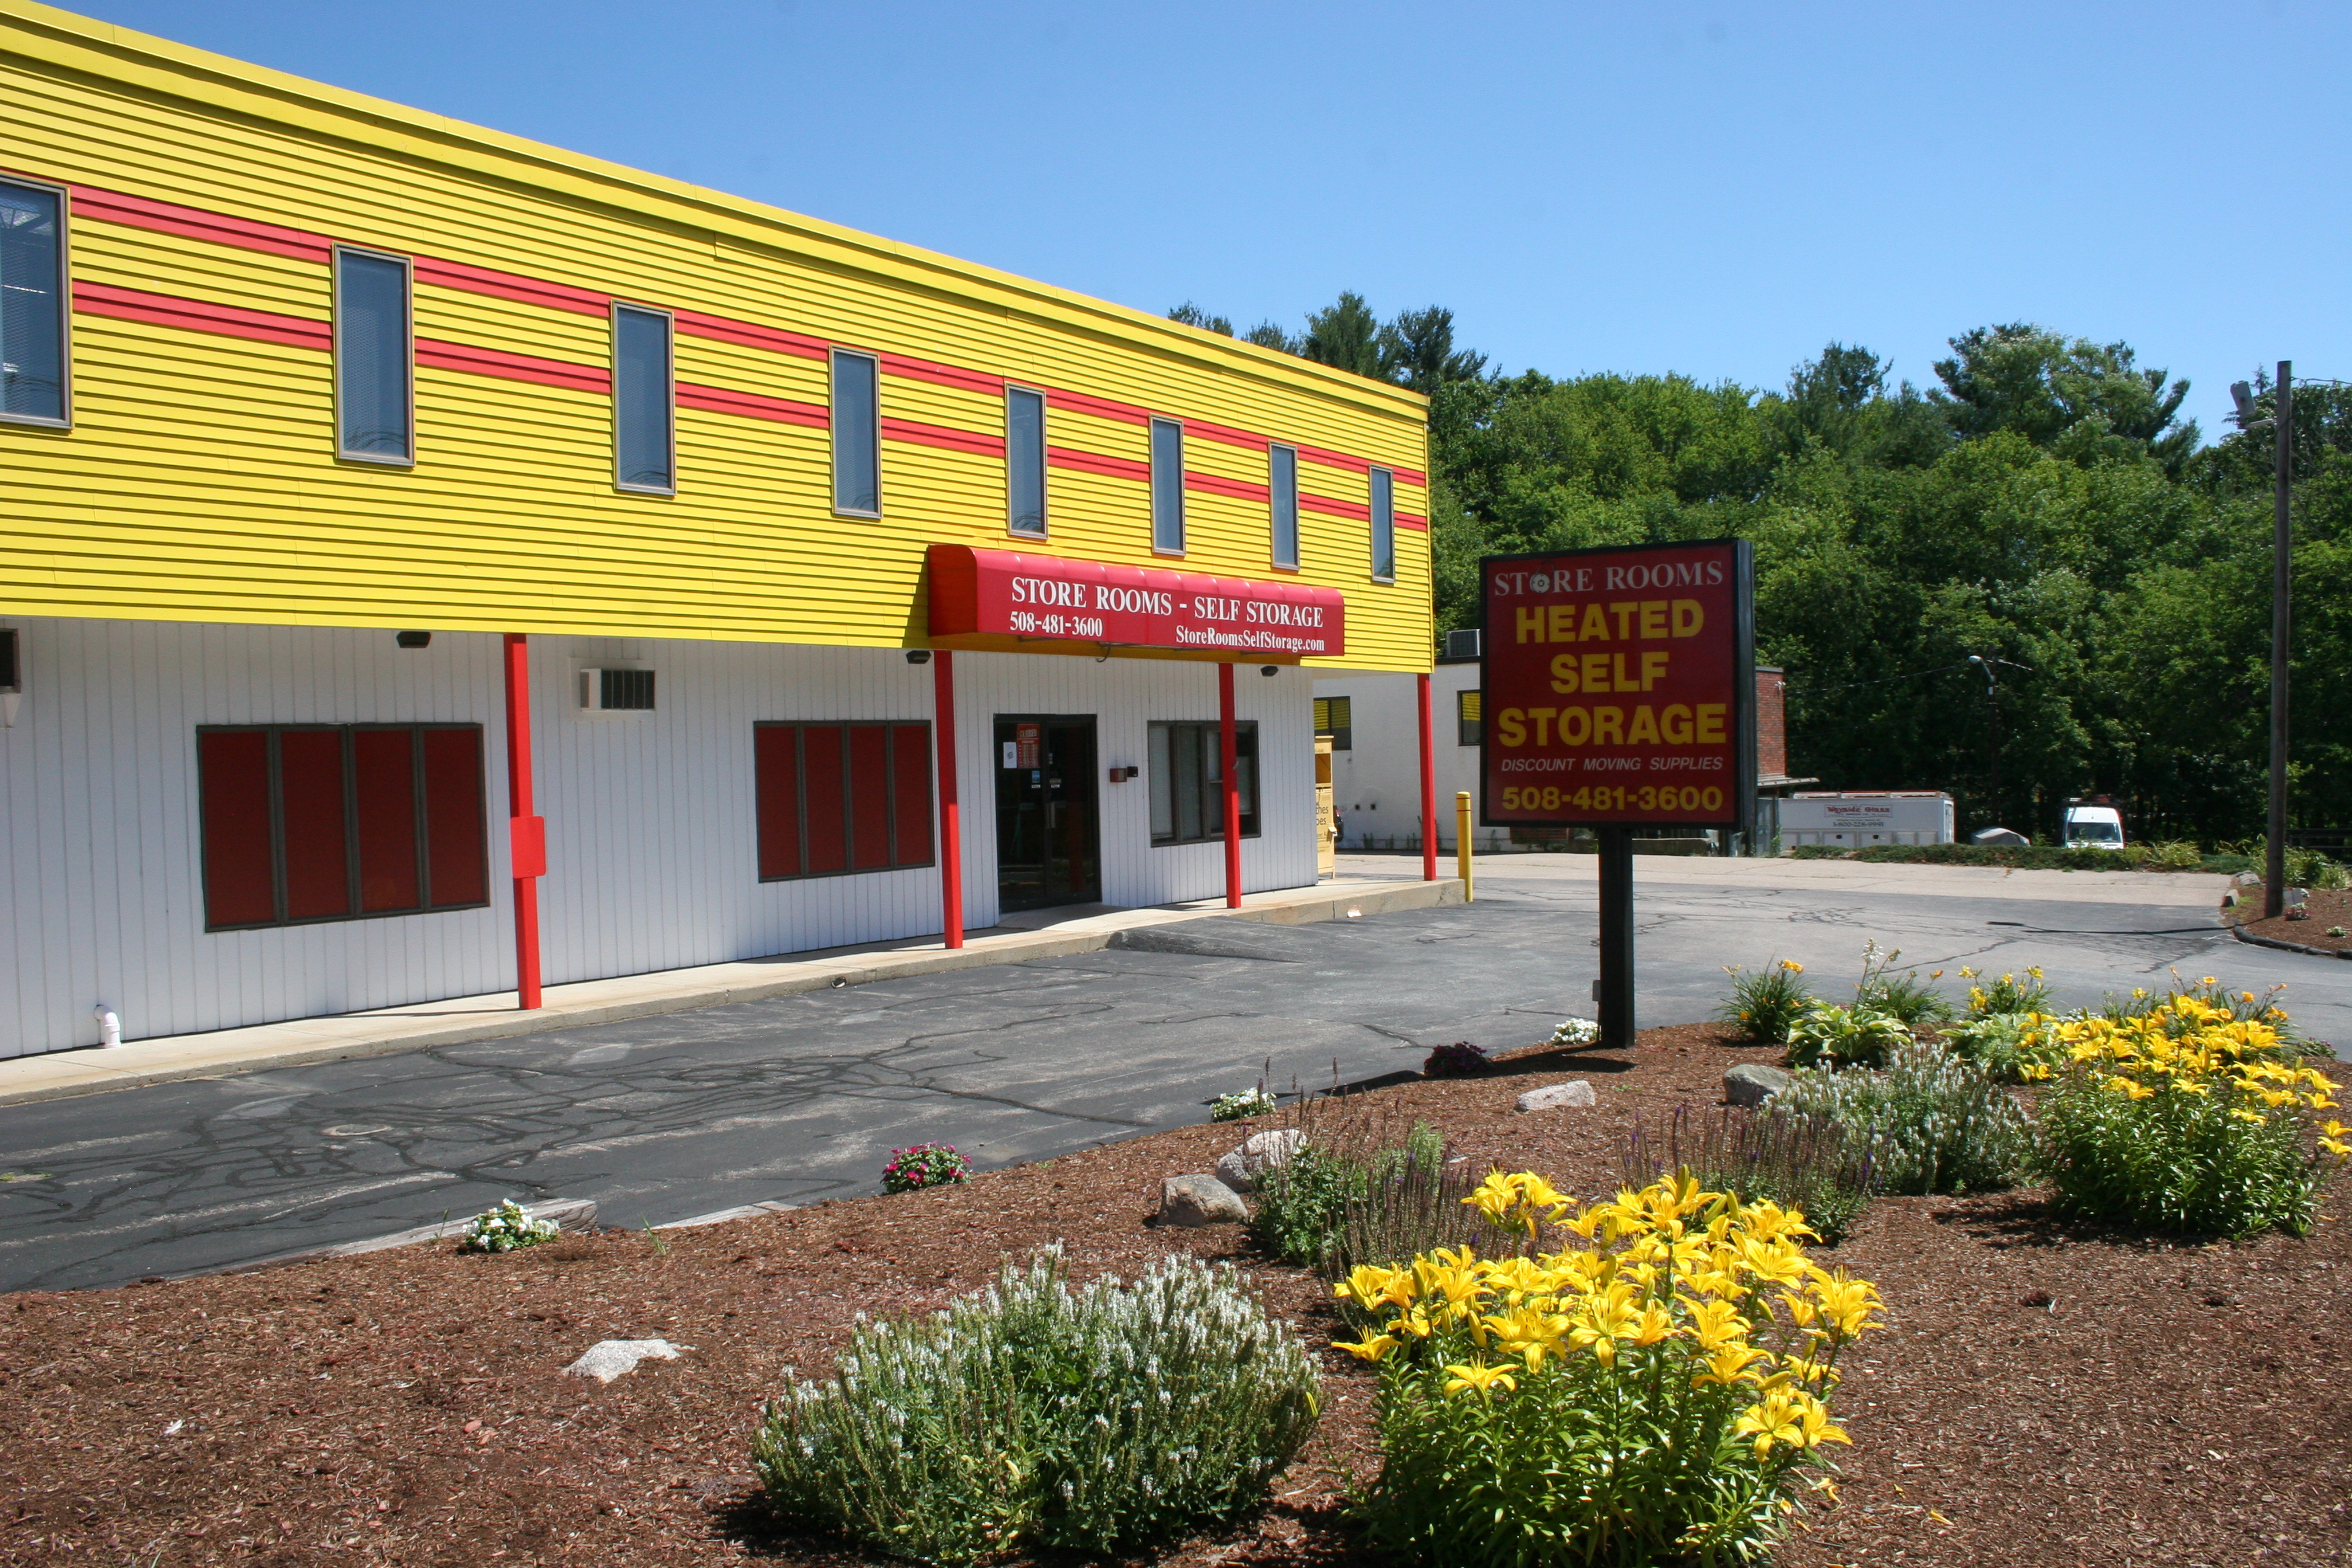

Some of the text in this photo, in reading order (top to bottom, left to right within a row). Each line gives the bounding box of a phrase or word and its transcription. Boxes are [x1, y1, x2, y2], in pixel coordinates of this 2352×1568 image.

[1495, 560, 1723, 597] STORE ROOMS
[1012, 577, 1087, 607] STORE
[1095, 585, 1173, 616] ROOMS
[1195, 595, 1240, 622] SELF
[1246, 601, 1324, 628] STORAGE
[1010, 611, 1103, 637] 508-481-3600
[1176, 625, 1325, 653] StoreRoomsSelfStorage.com
[1516, 599, 1704, 644] HEATED
[1551, 651, 1669, 694] SELF
[1498, 703, 1727, 747] STORAGE
[1501, 756, 1723, 772] DISCOUNT MOVING SUPPLIES
[1502, 786, 1723, 811] 508-481-3600
